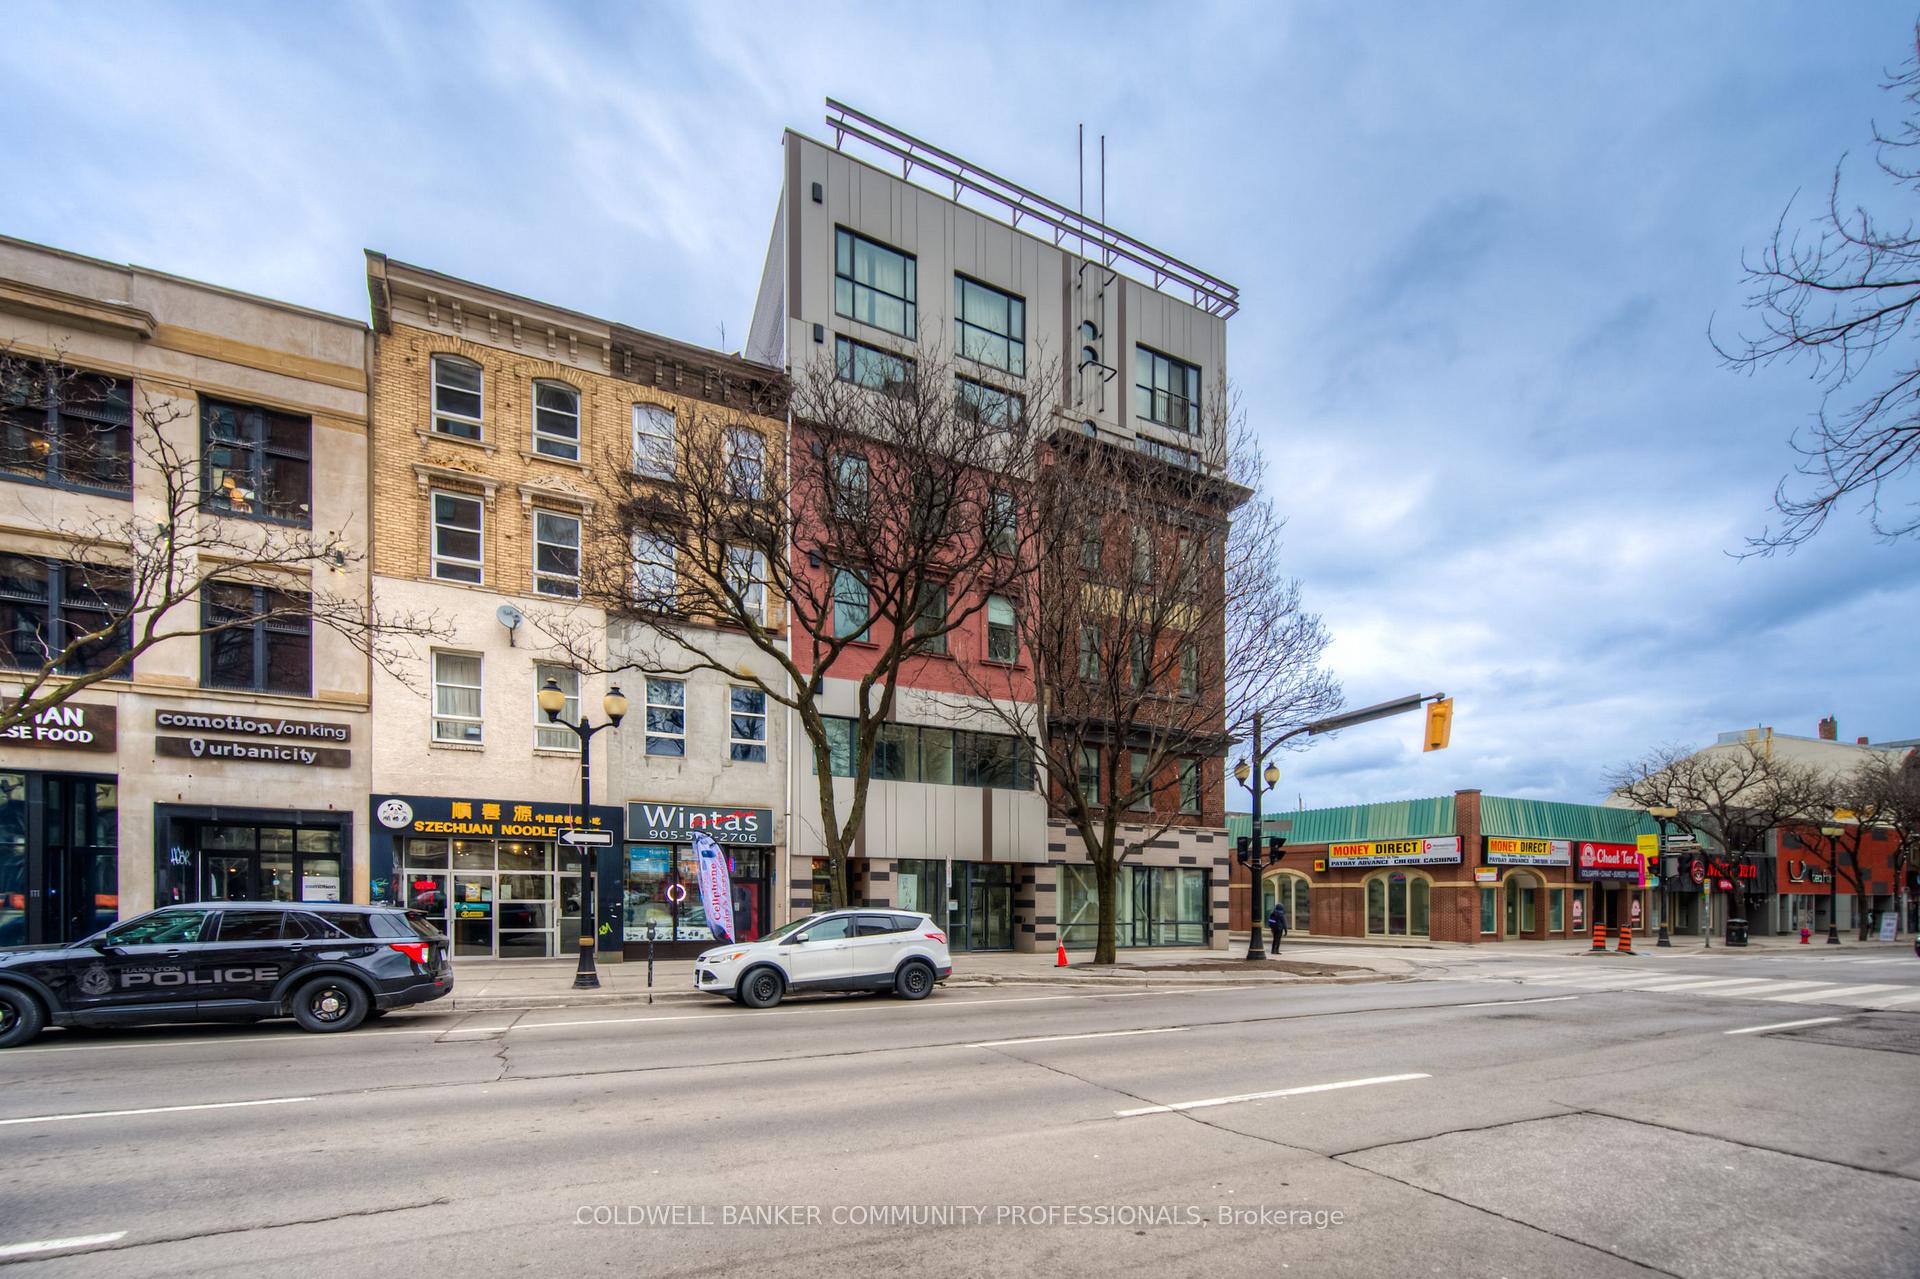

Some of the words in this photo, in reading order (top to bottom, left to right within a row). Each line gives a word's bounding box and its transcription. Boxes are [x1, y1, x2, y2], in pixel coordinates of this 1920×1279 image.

[0, 725, 33, 739] SE
[36, 727, 93, 743] FOOD
[310, 723, 347, 740] king
[209, 743, 318, 765] urbanicity
[643, 805, 758, 832] Wintas
[414, 820, 493, 834] SZECHUAN
[501, 824, 557, 837] NOODLE
[649, 829, 757, 843] 905-52-2706
[1332, 844, 1370, 857] MONEY
[1375, 841, 1418, 855] DIRECT
[1490, 840, 1517, 852] MONEY
[1520, 841, 1547, 853] DIRECT
[1423, 856, 1458, 864] CASHING
[711, 863, 721, 921] Cellphone
[120, 965, 181, 974] HAMILTON
[120, 967, 279, 988] POLICE
